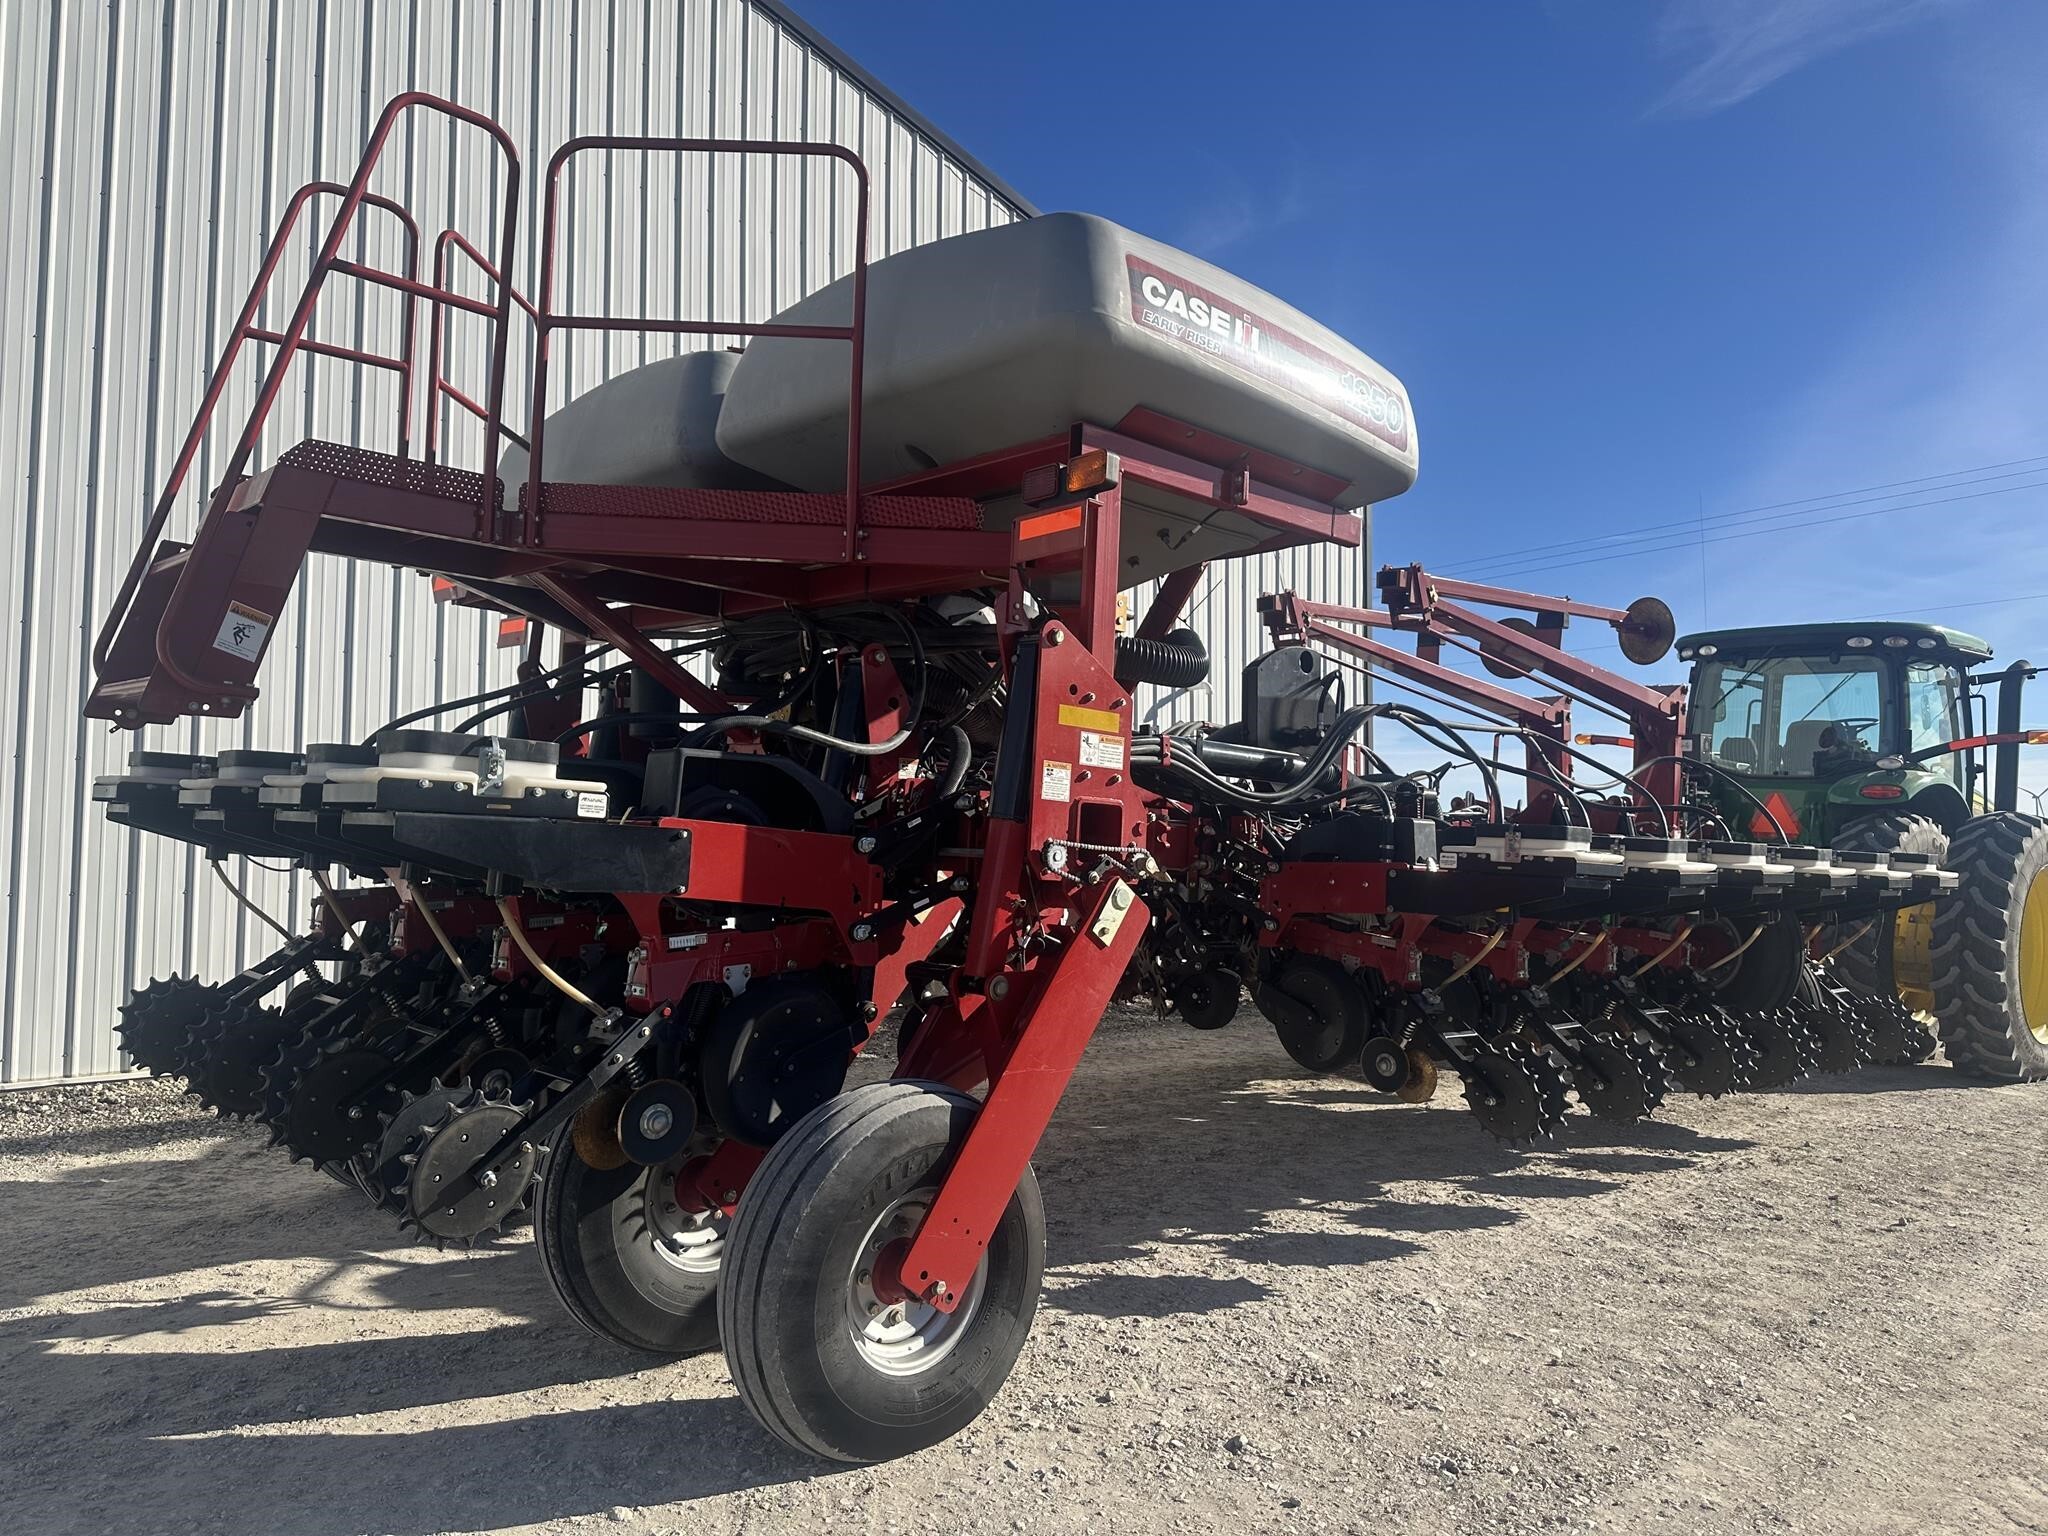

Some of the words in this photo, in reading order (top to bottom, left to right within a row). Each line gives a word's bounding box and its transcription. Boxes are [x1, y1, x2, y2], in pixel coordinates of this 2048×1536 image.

[1142, 276, 1231, 339] CASE
[1142, 309, 1185, 337] EARLY
[1186, 327, 1223, 355] RISER
[1342, 372, 1403, 433] 1250
